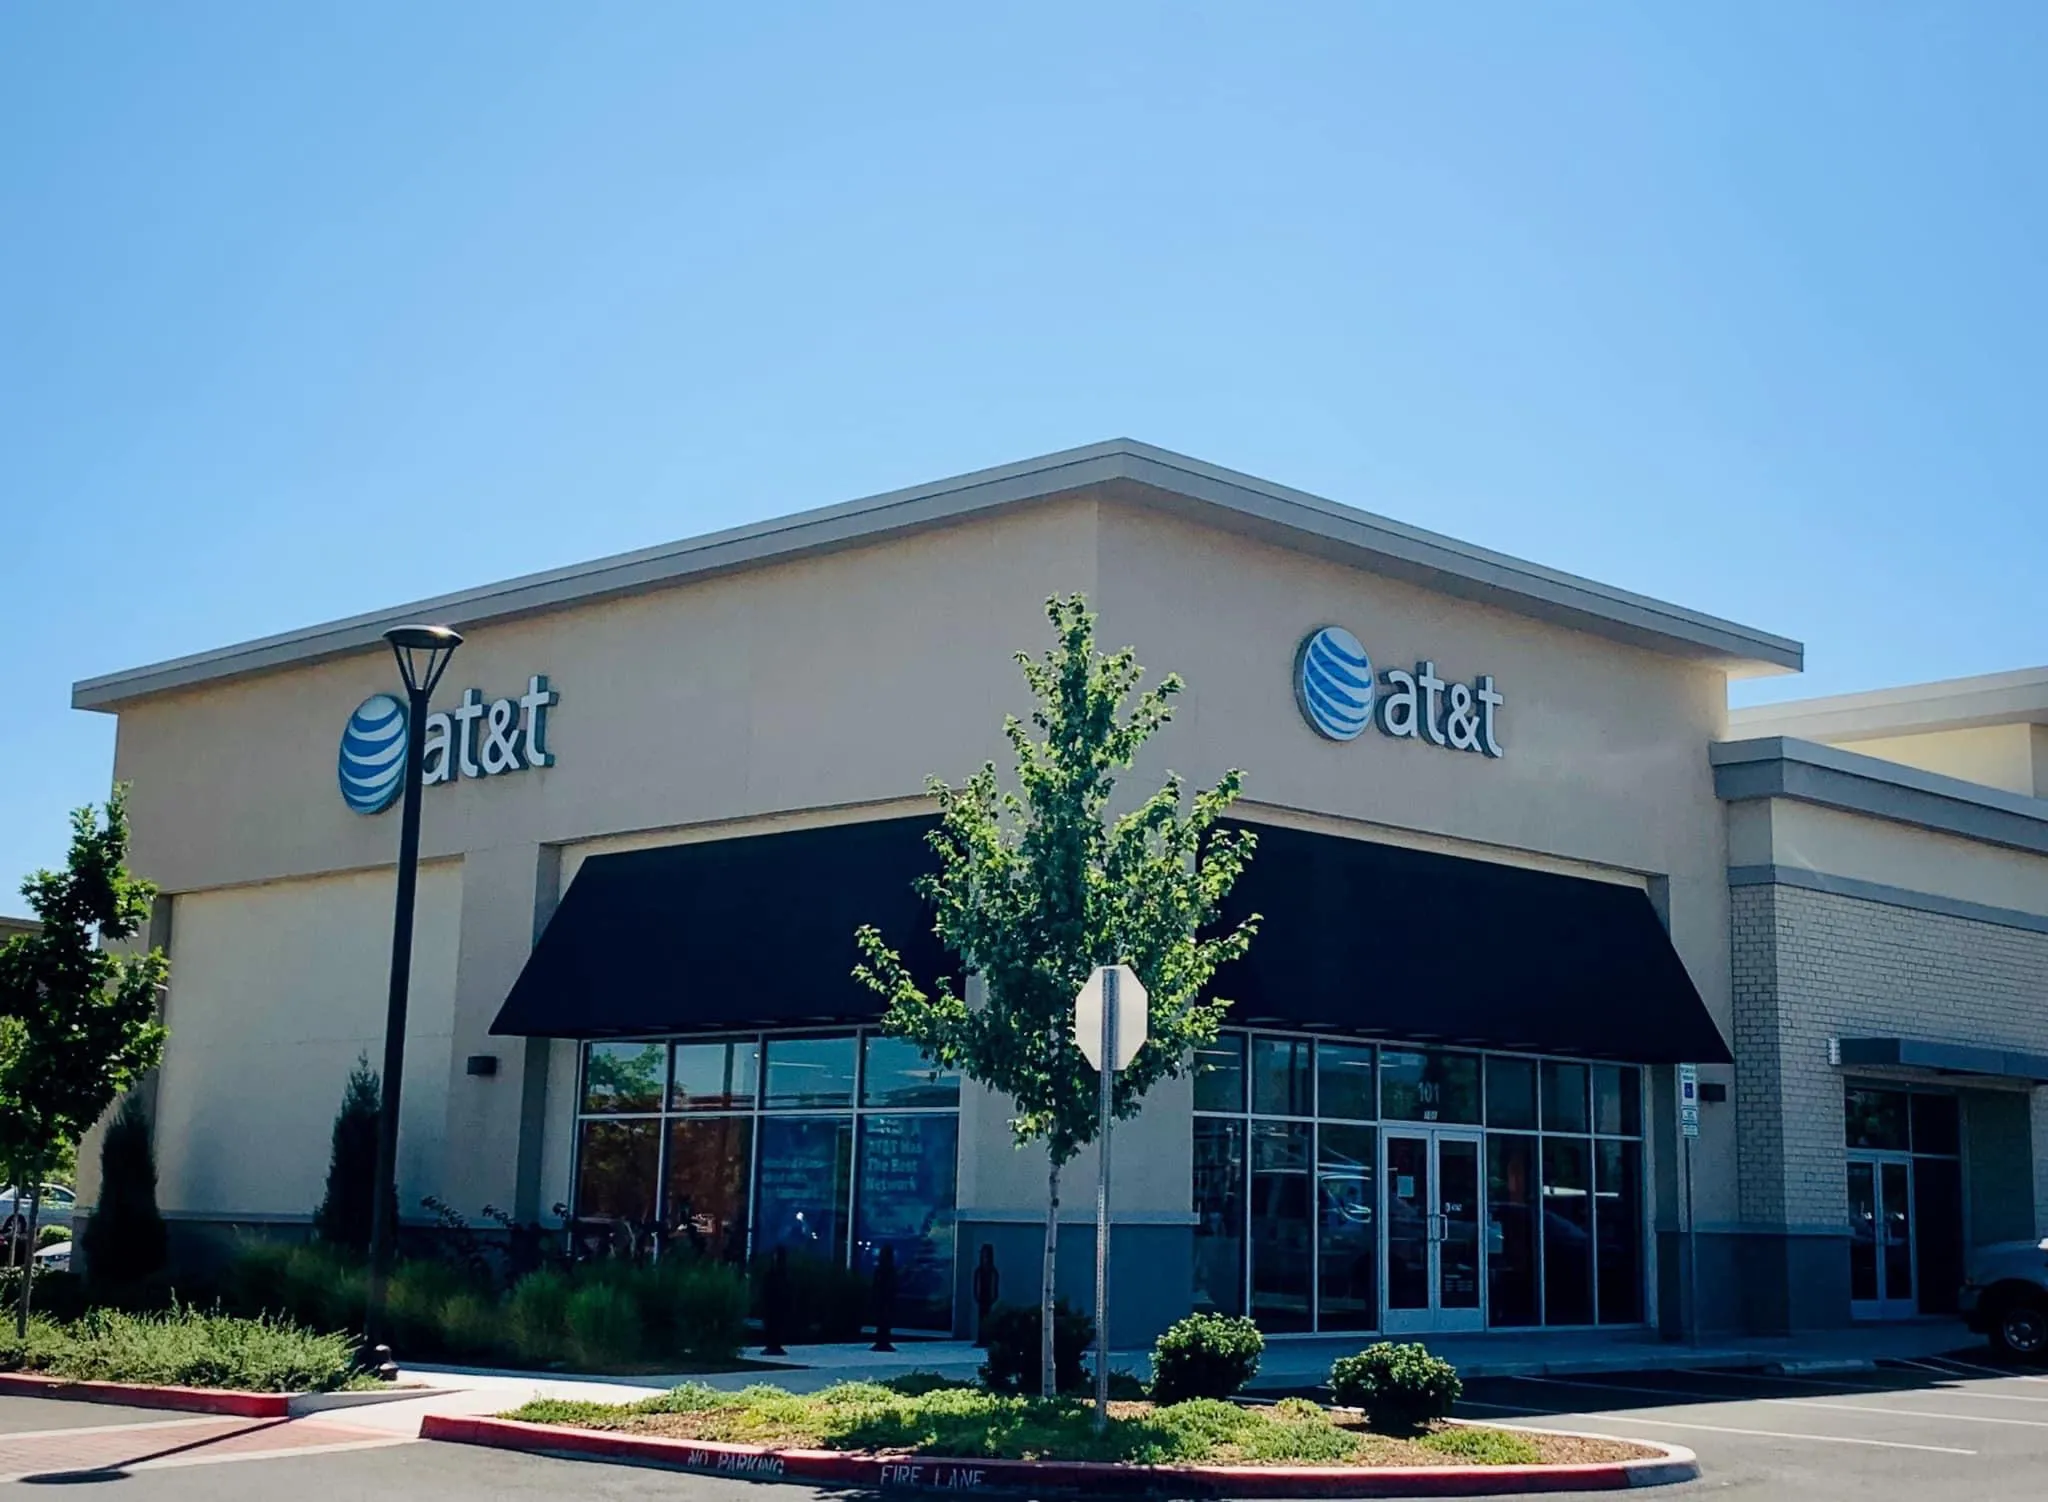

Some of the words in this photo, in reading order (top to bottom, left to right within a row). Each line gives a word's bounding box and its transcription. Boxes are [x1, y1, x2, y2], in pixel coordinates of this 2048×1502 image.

[1377, 660, 1504, 758] at&t
[423, 675, 558, 786] at&t
[1418, 1081, 1440, 1104] 101
[687, 1449, 709, 1467] NO
[717, 1453, 785, 1475] PARKING
[880, 1464, 924, 1485] FIRE
[934, 1467, 986, 1490] LANE
